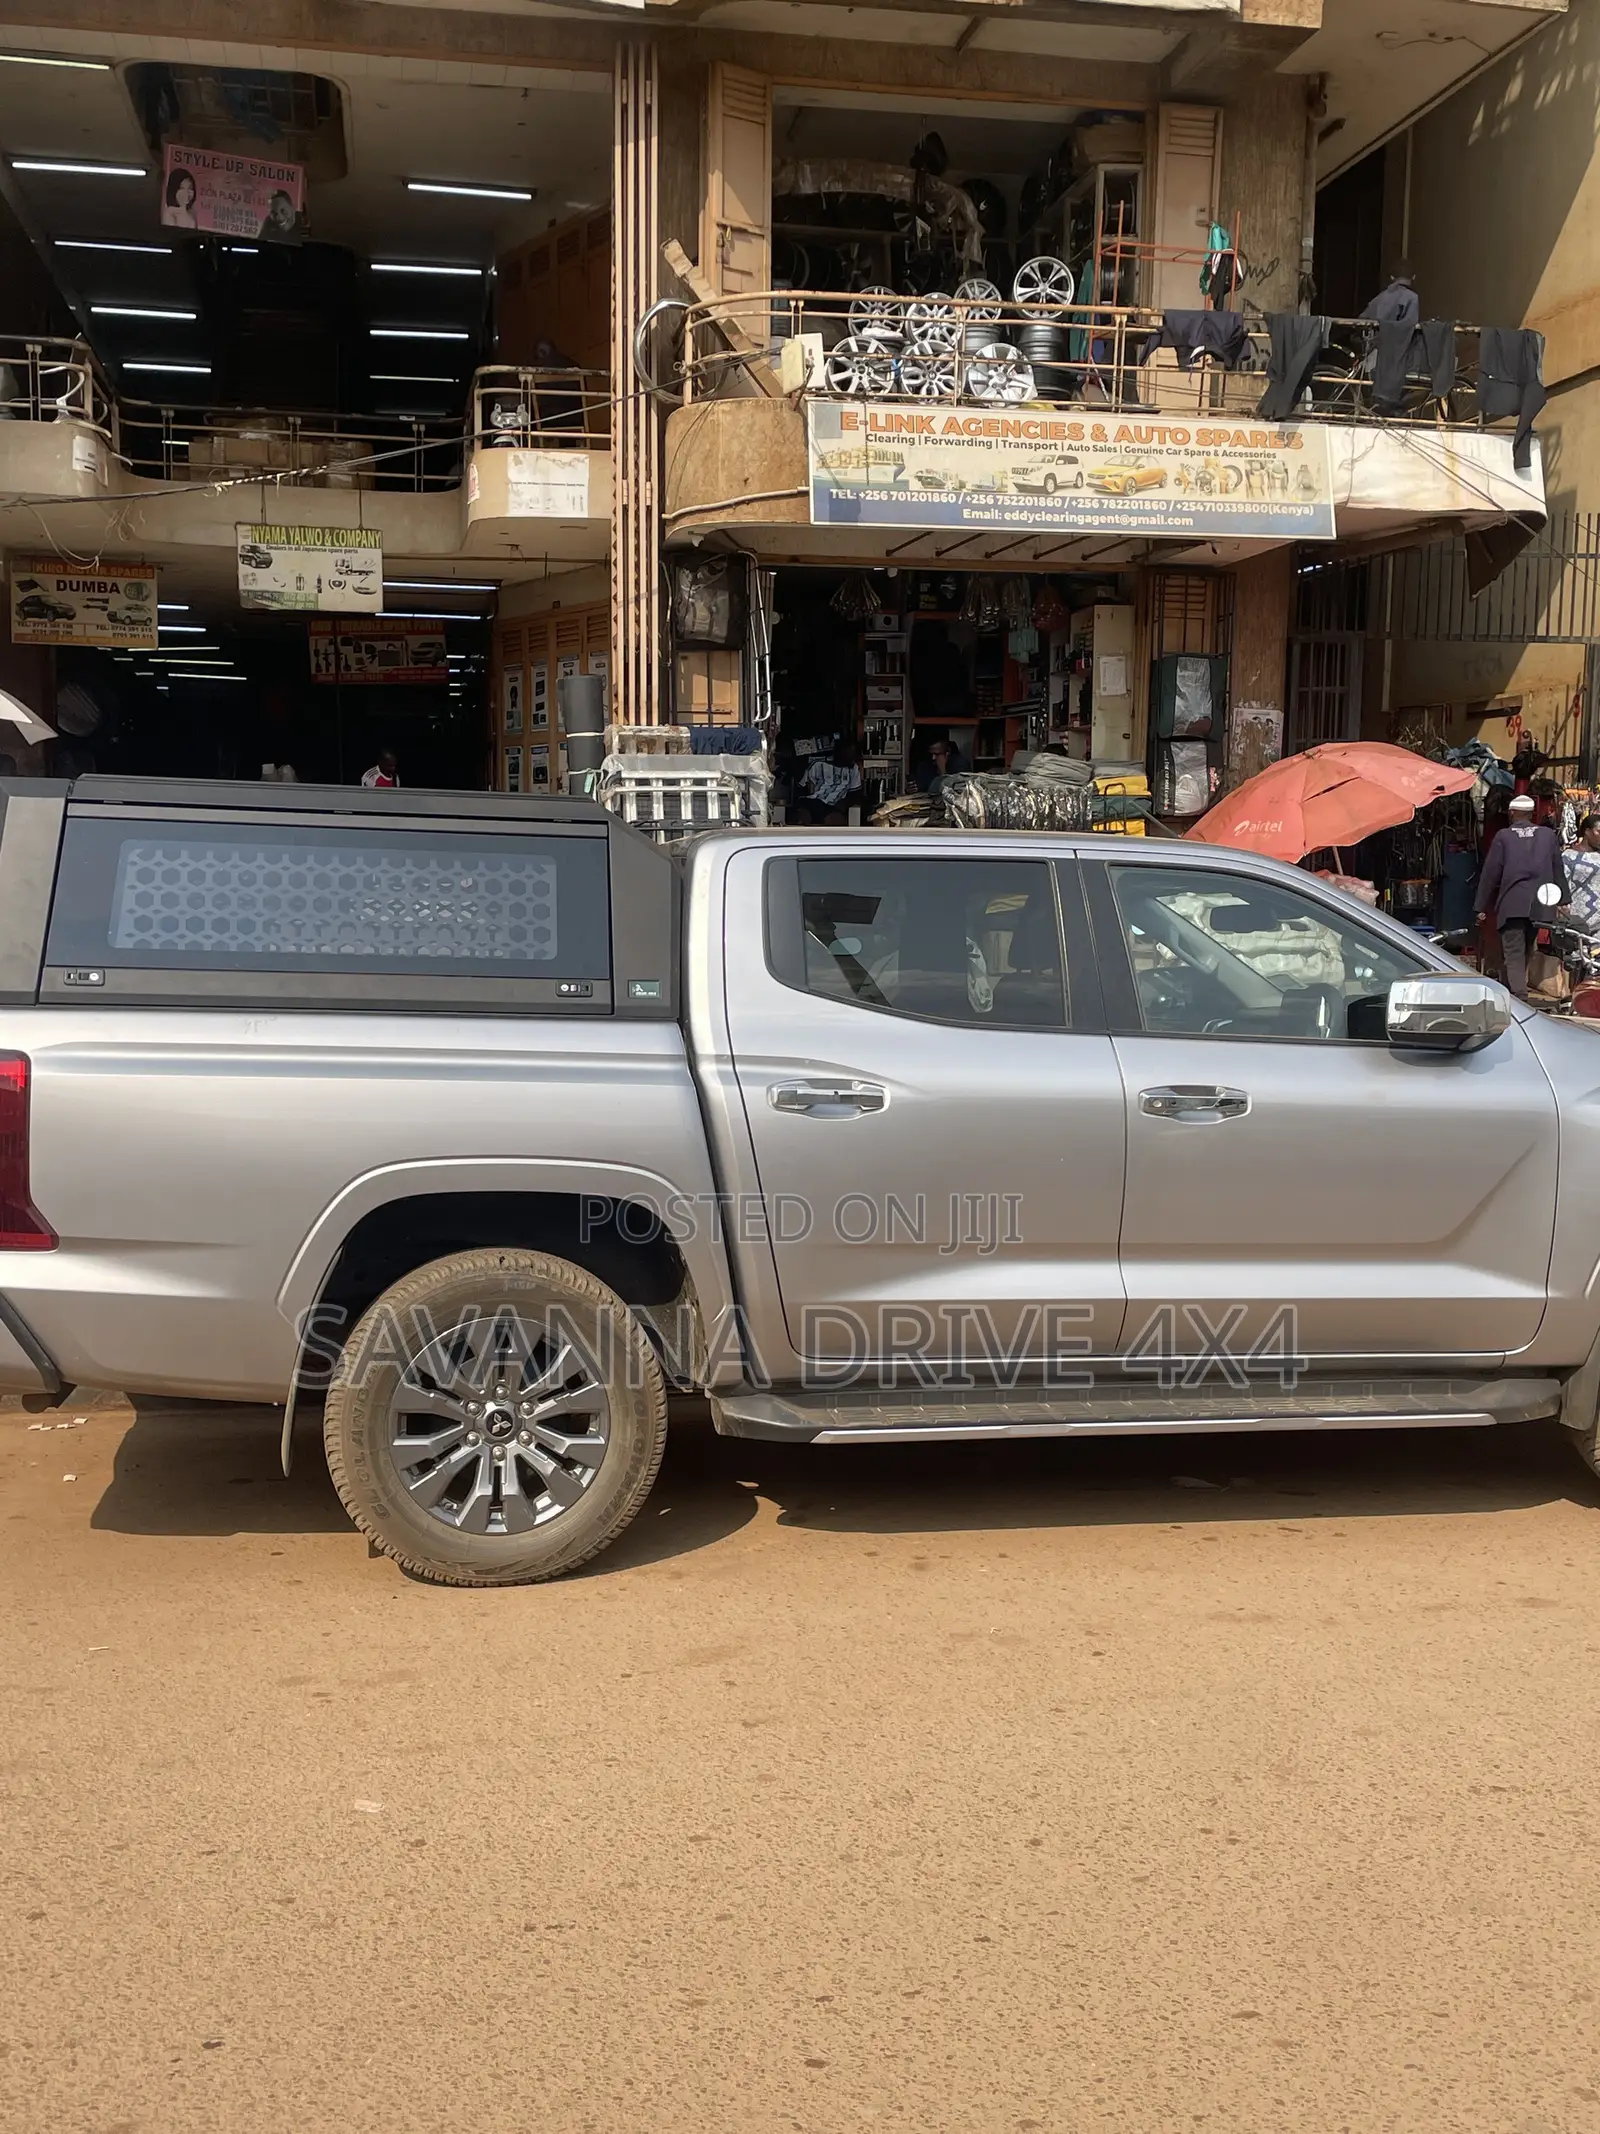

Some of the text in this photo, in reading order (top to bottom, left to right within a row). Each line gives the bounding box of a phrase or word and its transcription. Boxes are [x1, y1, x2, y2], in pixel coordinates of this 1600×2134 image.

[173, 151, 296, 182] STYLE UP SALON
[840, 411, 1304, 450] E-LINK AGENCIES & AUTO SPARES
[866, 433, 915, 446] Clearing
[924, 436, 993, 450] Forwarding
[1001, 440, 1058, 451] Transport
[1066, 443, 1090, 452] Auto
[1092, 444, 1118, 453] Sales
[1124, 445, 1164, 455] Genuine
[1165, 447, 1182, 456] Car
[1183, 448, 1211, 458] Spare
[1213, 449, 1219, 457] &
[1221, 449, 1277, 459] Accessories
[830, 488, 857, 499] TEL:
[859, 489, 888, 501] +256
[889, 490, 956, 503] 701201860
[965, 493, 995, 504] +256
[996, 495, 1062, 507] 752201860
[1071, 498, 1099, 509] +256
[1102, 499, 1167, 510] 782201860
[963, 508, 1193, 526] Email: eddyclearingagent@gmail.com
[251, 526, 287, 544] NYAMA
[288, 527, 321, 545] YALWO
[324, 529, 333, 546] &
[333, 529, 381, 548] COMPANY
[110, 566, 154, 578] SPARES
[56, 579, 121, 594] DUMBA
[1249, 821, 1282, 833] airtel
